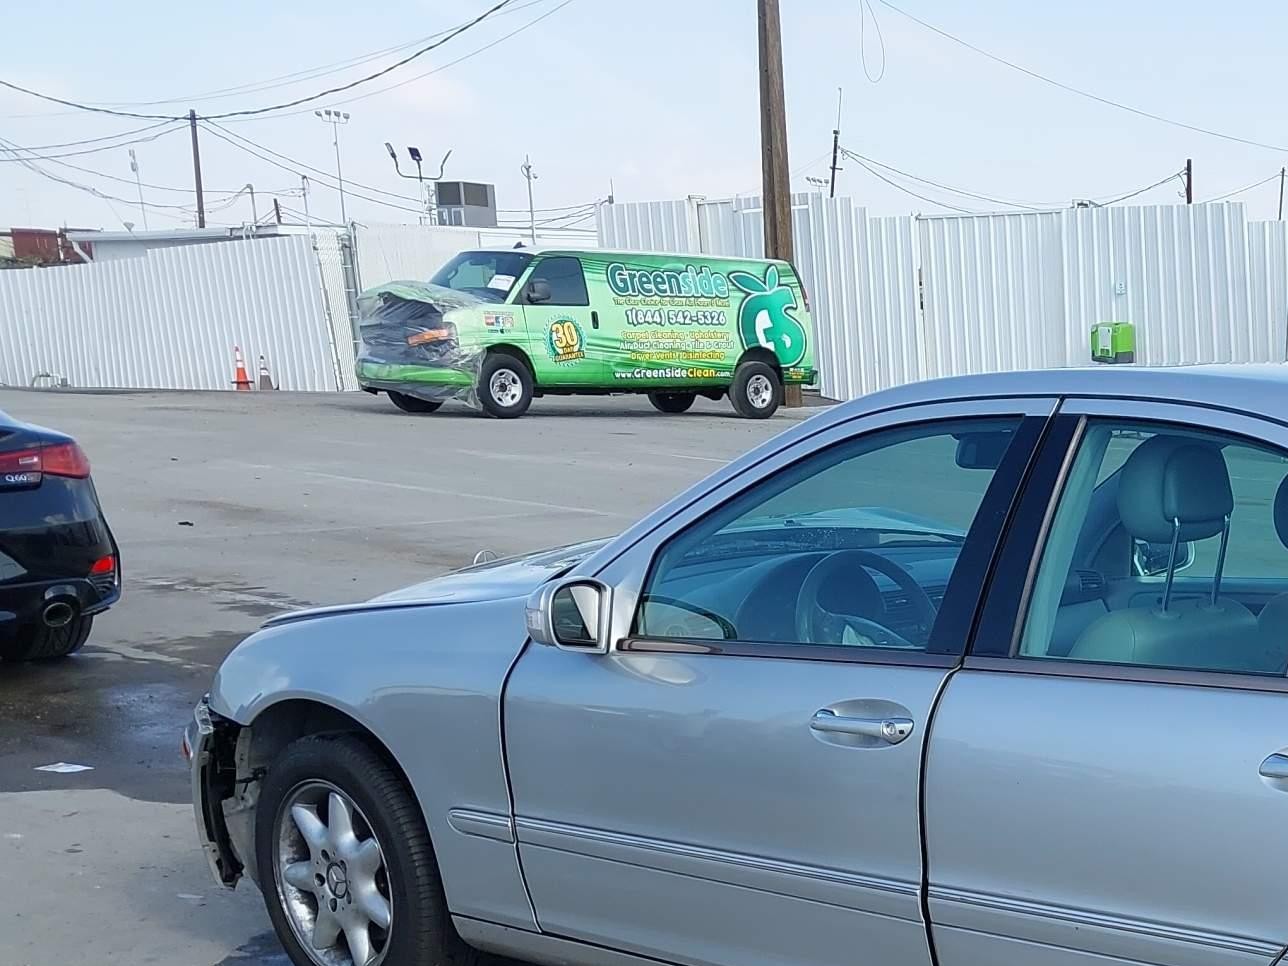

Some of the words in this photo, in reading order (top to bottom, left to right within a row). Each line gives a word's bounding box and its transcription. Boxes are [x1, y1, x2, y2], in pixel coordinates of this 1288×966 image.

[626, 308, 665, 326] 1(844)
[668, 309, 726, 326] 542-5326
[552, 322, 578, 347] 30
[621, 331, 649, 340] Carpet
[651, 330, 686, 341] Cleaning
[652, 341, 686, 351] Cleaning
